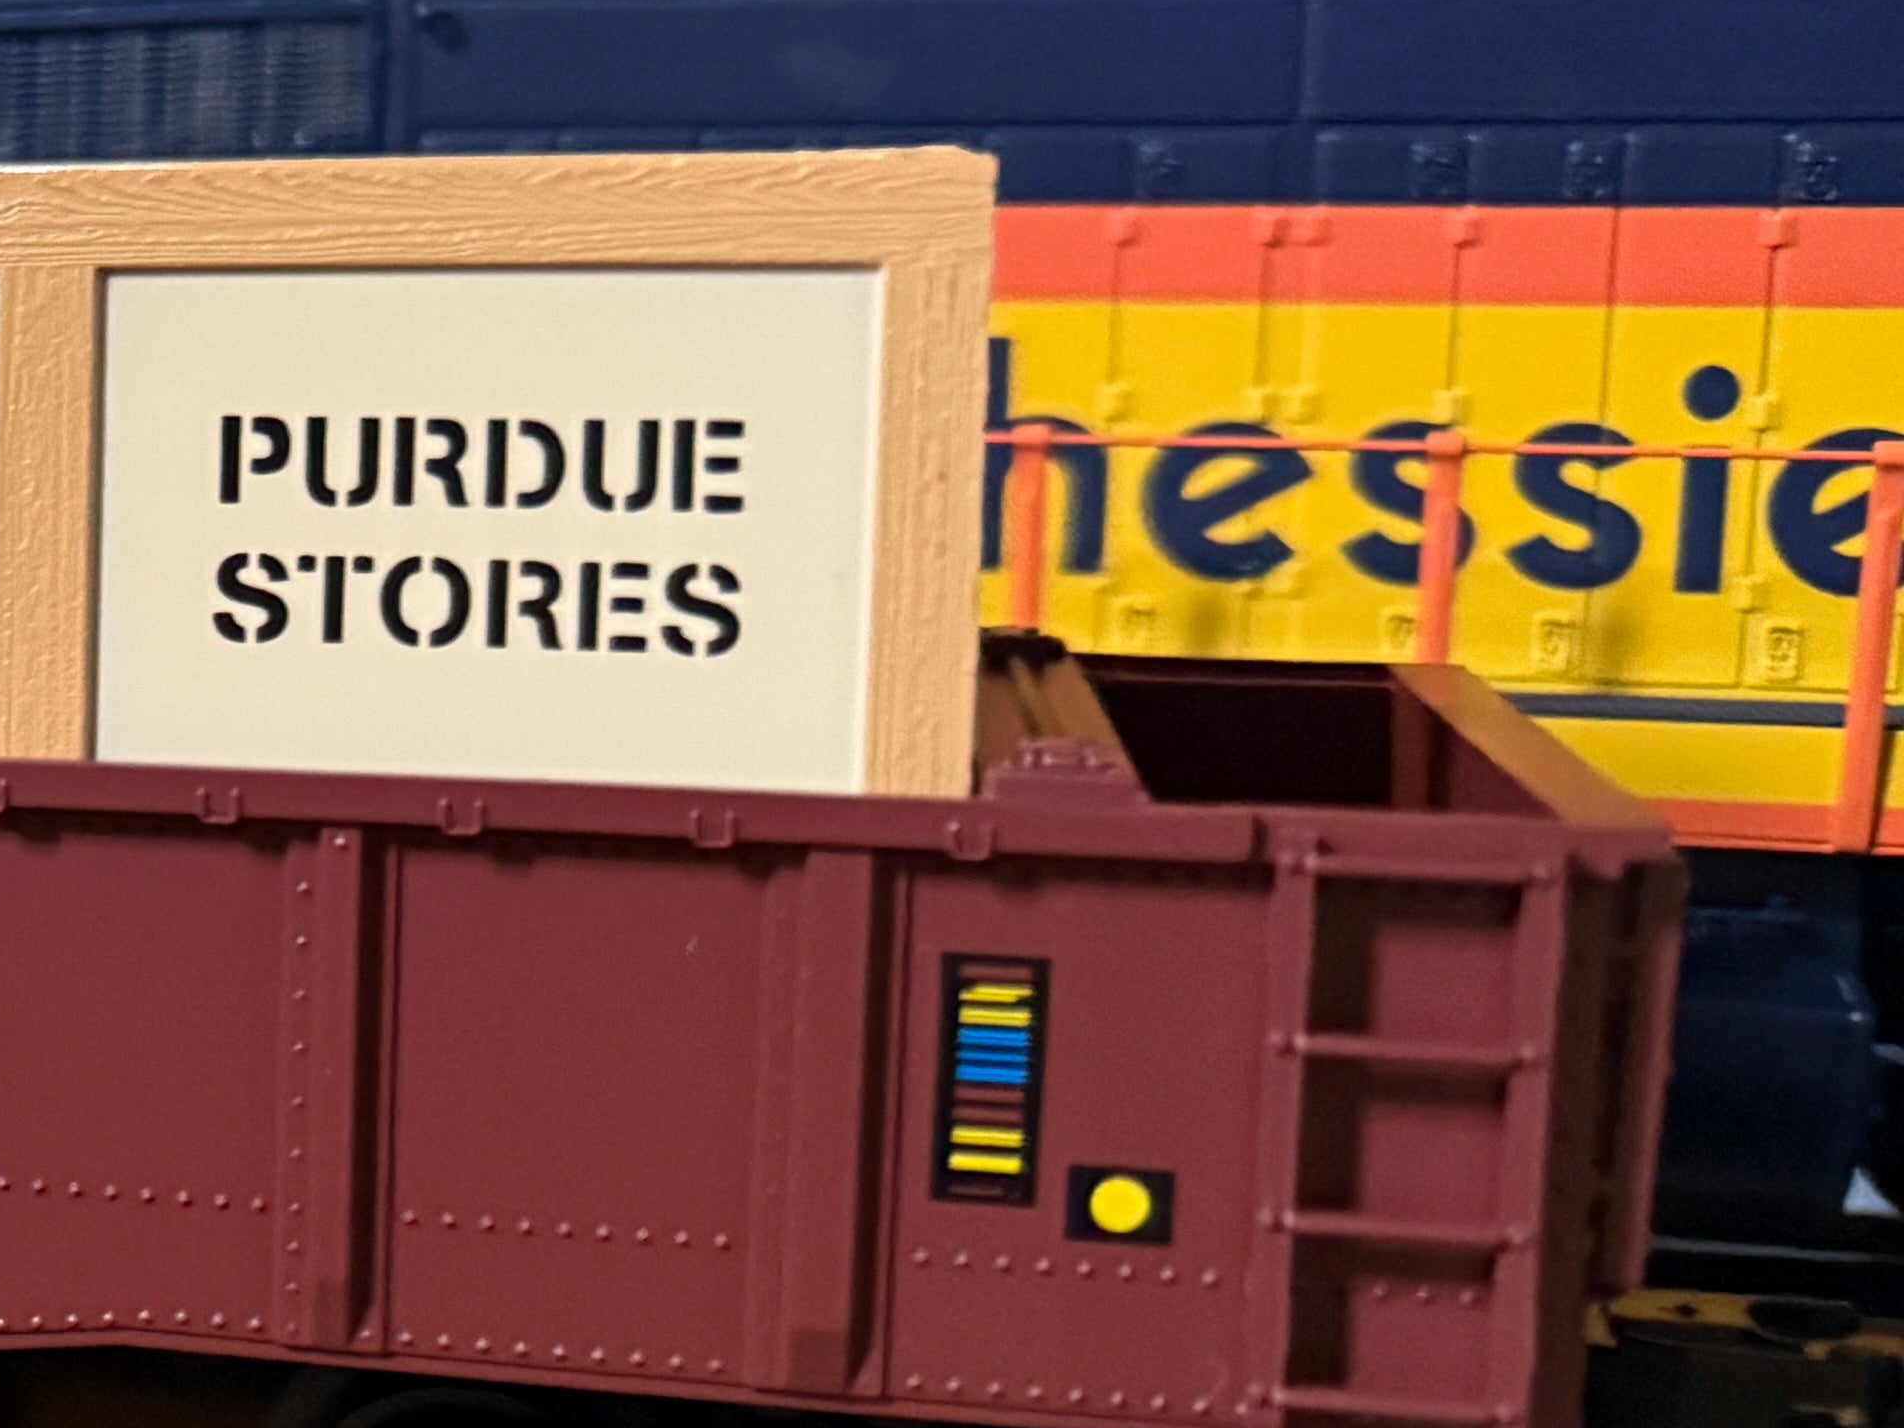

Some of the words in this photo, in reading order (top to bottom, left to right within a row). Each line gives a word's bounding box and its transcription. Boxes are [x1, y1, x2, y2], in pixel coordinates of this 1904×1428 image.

[217, 412, 747, 516] PURDUE
[980, 336, 1904, 598] hessie
[211, 550, 744, 659] STORES
